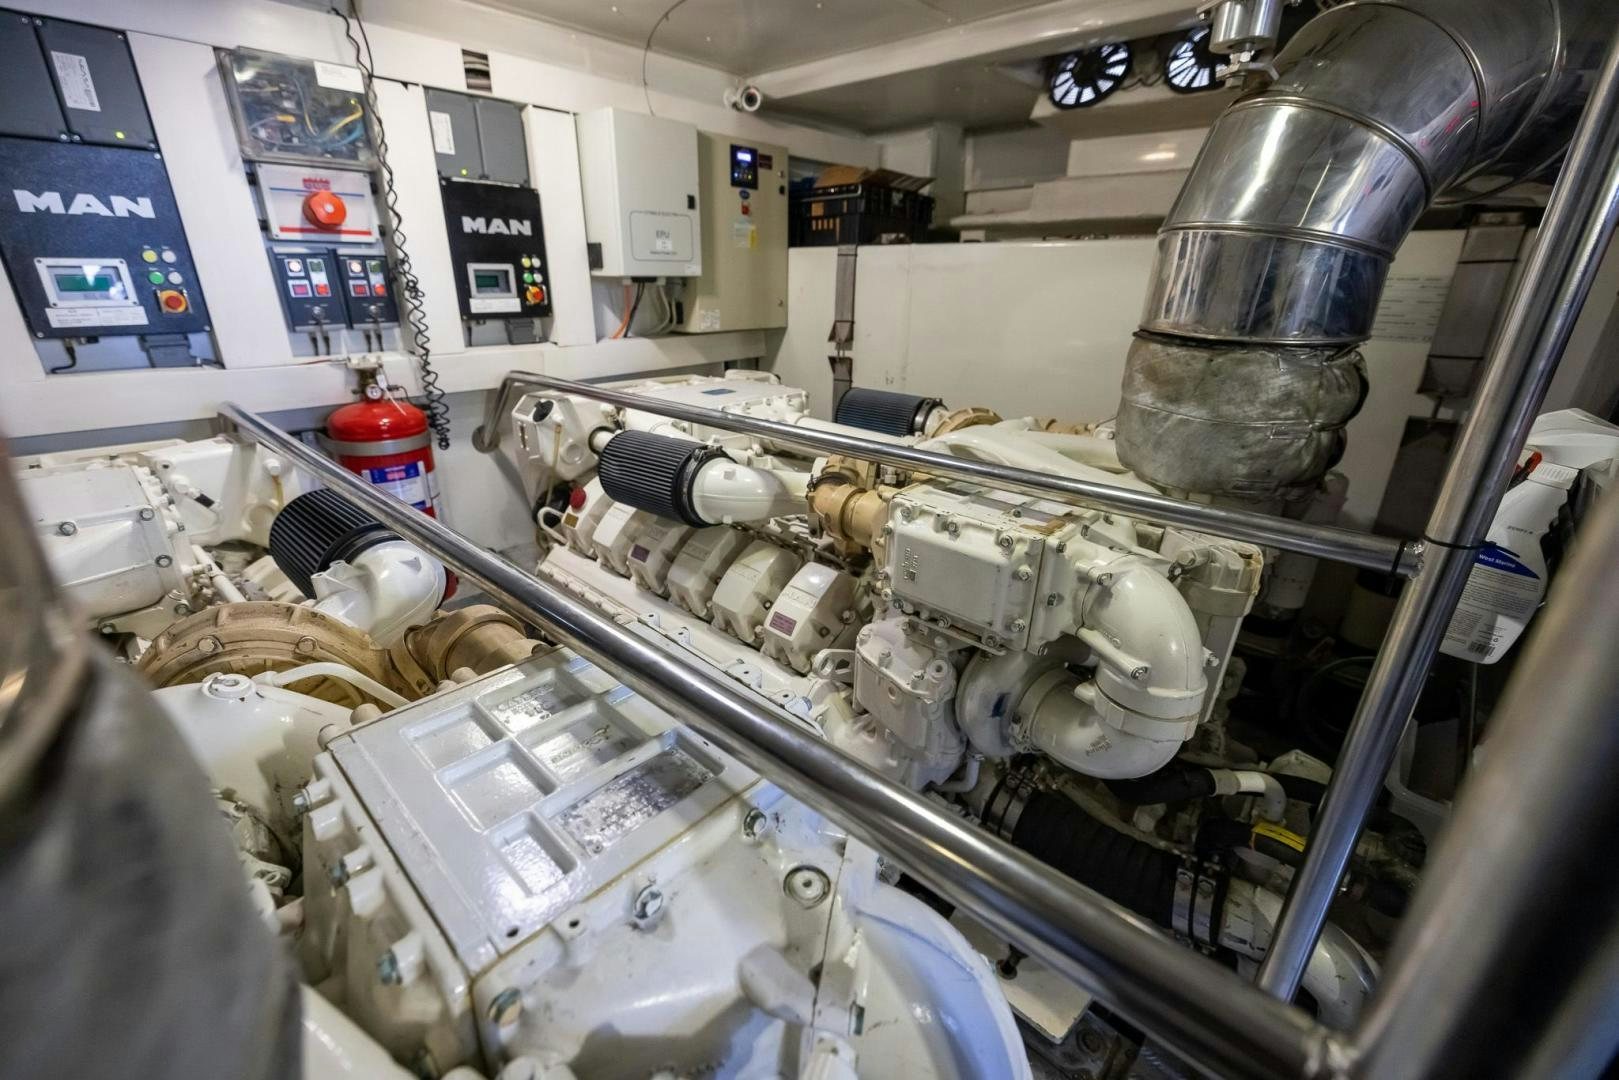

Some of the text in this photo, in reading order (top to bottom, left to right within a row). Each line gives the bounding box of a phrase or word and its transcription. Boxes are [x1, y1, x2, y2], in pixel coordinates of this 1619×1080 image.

[13, 189, 156, 218] MAN
[461, 216, 532, 236] MAN
[1479, 554, 1495, 563] West
